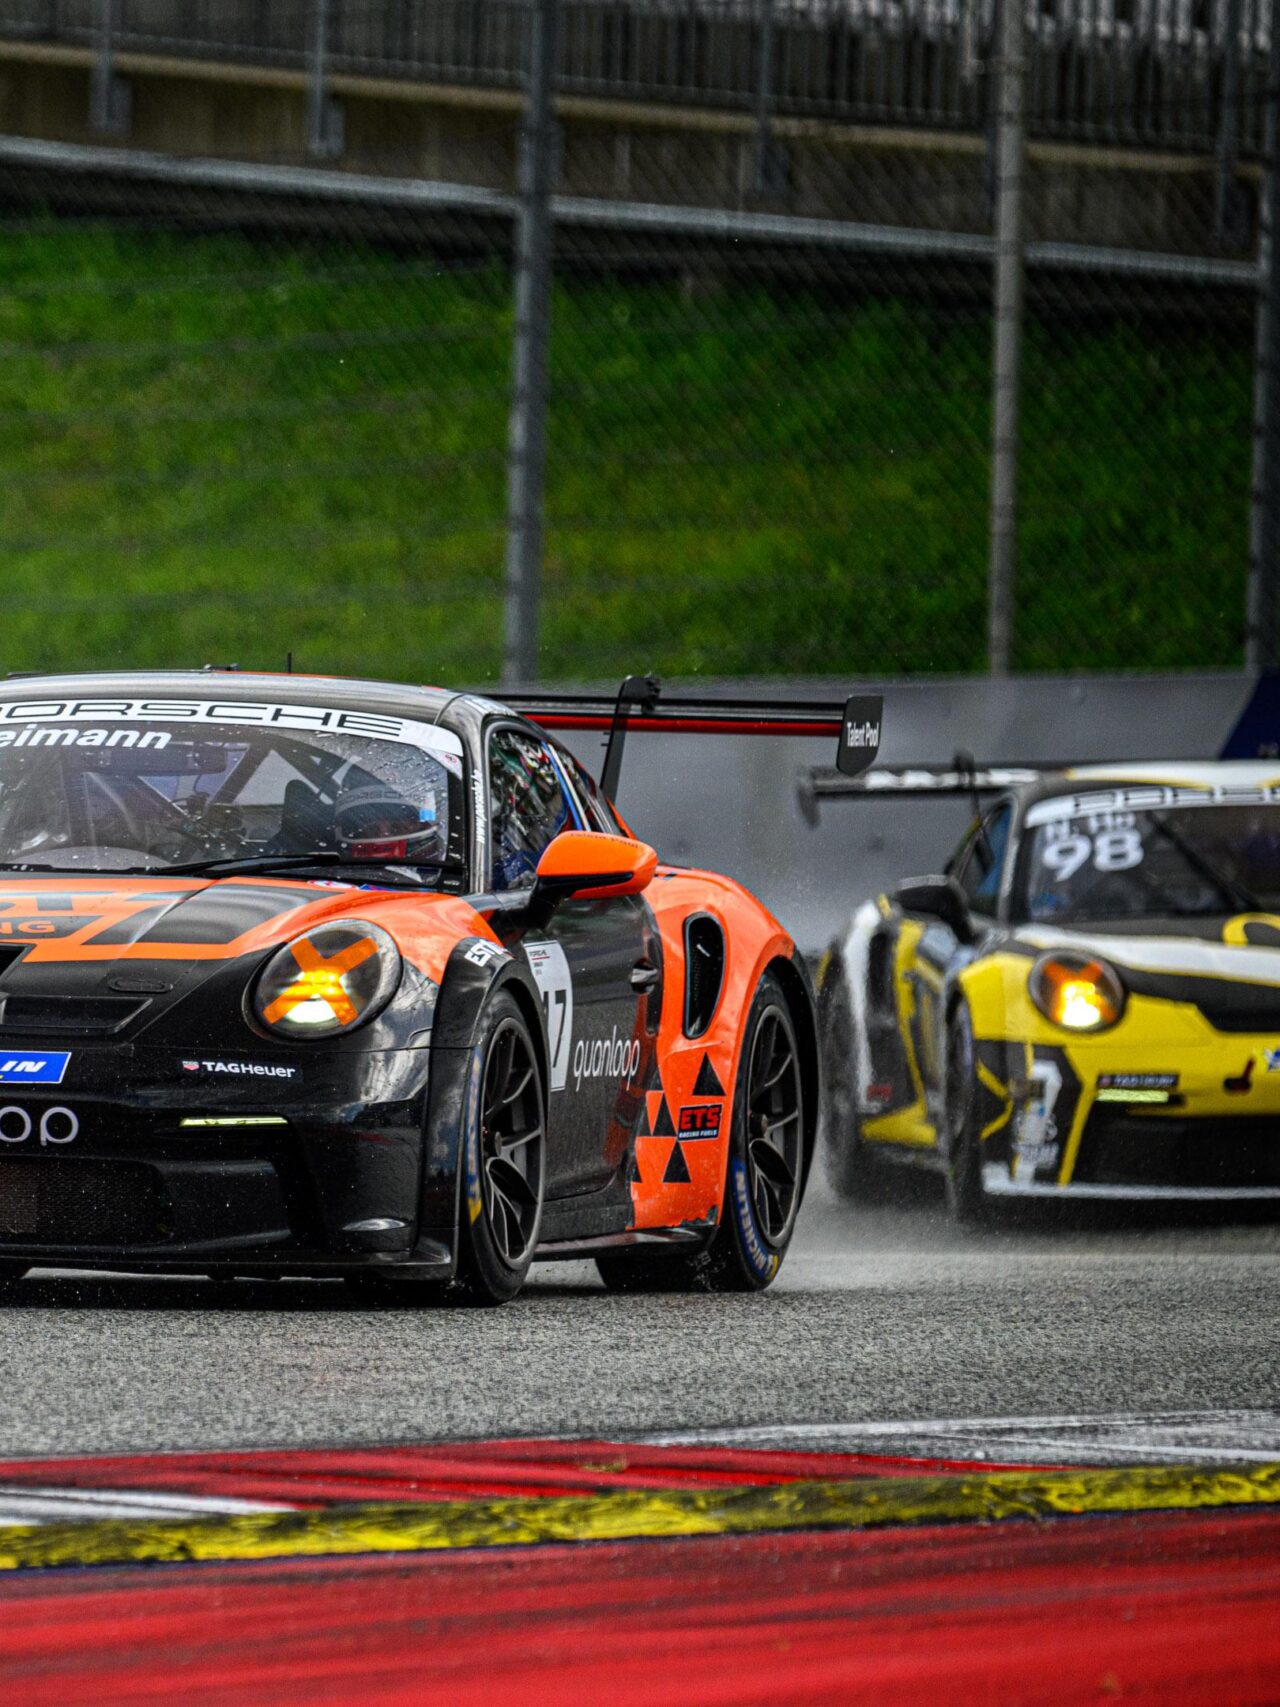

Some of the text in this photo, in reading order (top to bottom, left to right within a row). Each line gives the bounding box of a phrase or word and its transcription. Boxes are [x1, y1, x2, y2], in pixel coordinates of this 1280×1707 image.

[1042, 829, 1144, 882] 98
[573, 1025, 640, 1092] quanloop
[681, 1107, 720, 1129] ETS
